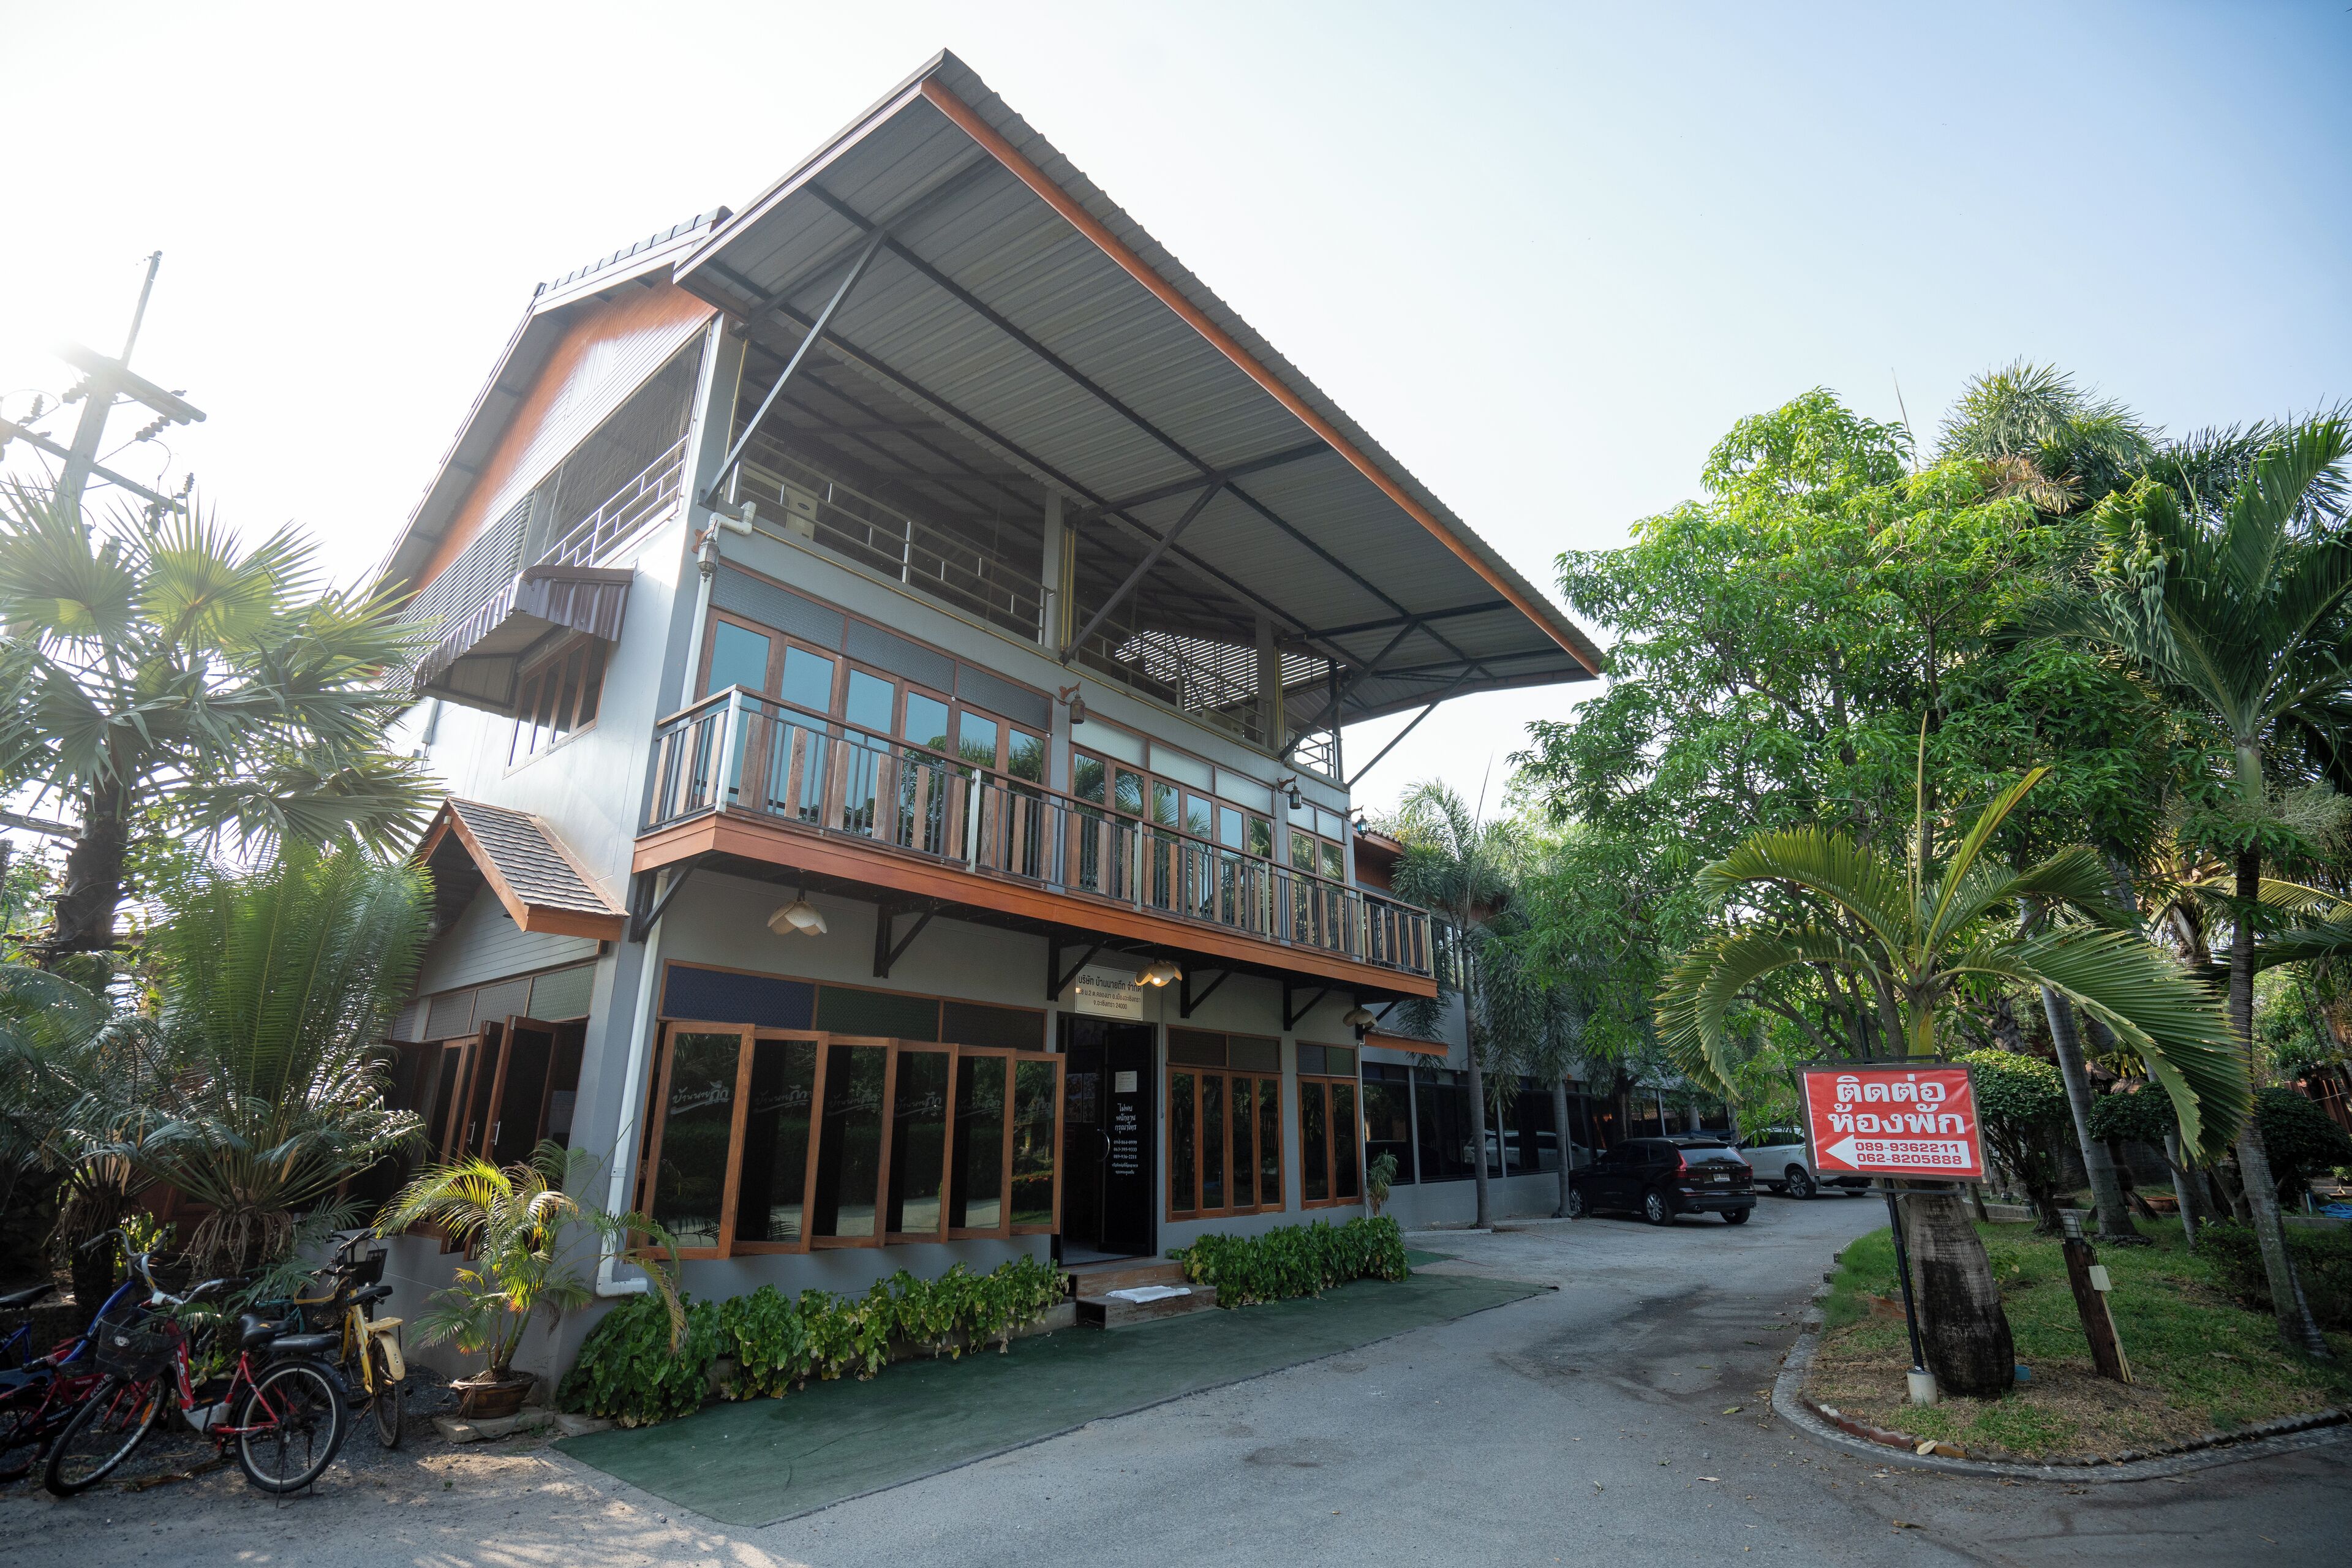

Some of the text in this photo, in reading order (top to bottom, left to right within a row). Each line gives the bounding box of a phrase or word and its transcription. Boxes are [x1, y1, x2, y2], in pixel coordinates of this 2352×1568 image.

[1078, 974, 1141, 993] บริษัท บ้านนายถึก จำกด
[1836, 1073, 1947, 1103] ติดต่อ
[1117, 1103, 1133, 1112] ไม่พบ
[1116, 1113, 1136, 1122] พนักงาน
[1827, 1103, 1966, 1134] ห้องพัก
[1115, 1121, 1137, 1134] กรุณาโทร
[1855, 1142, 1959, 1153] 089-9362211
[1856, 1153, 1962, 1165] 062-8205888
